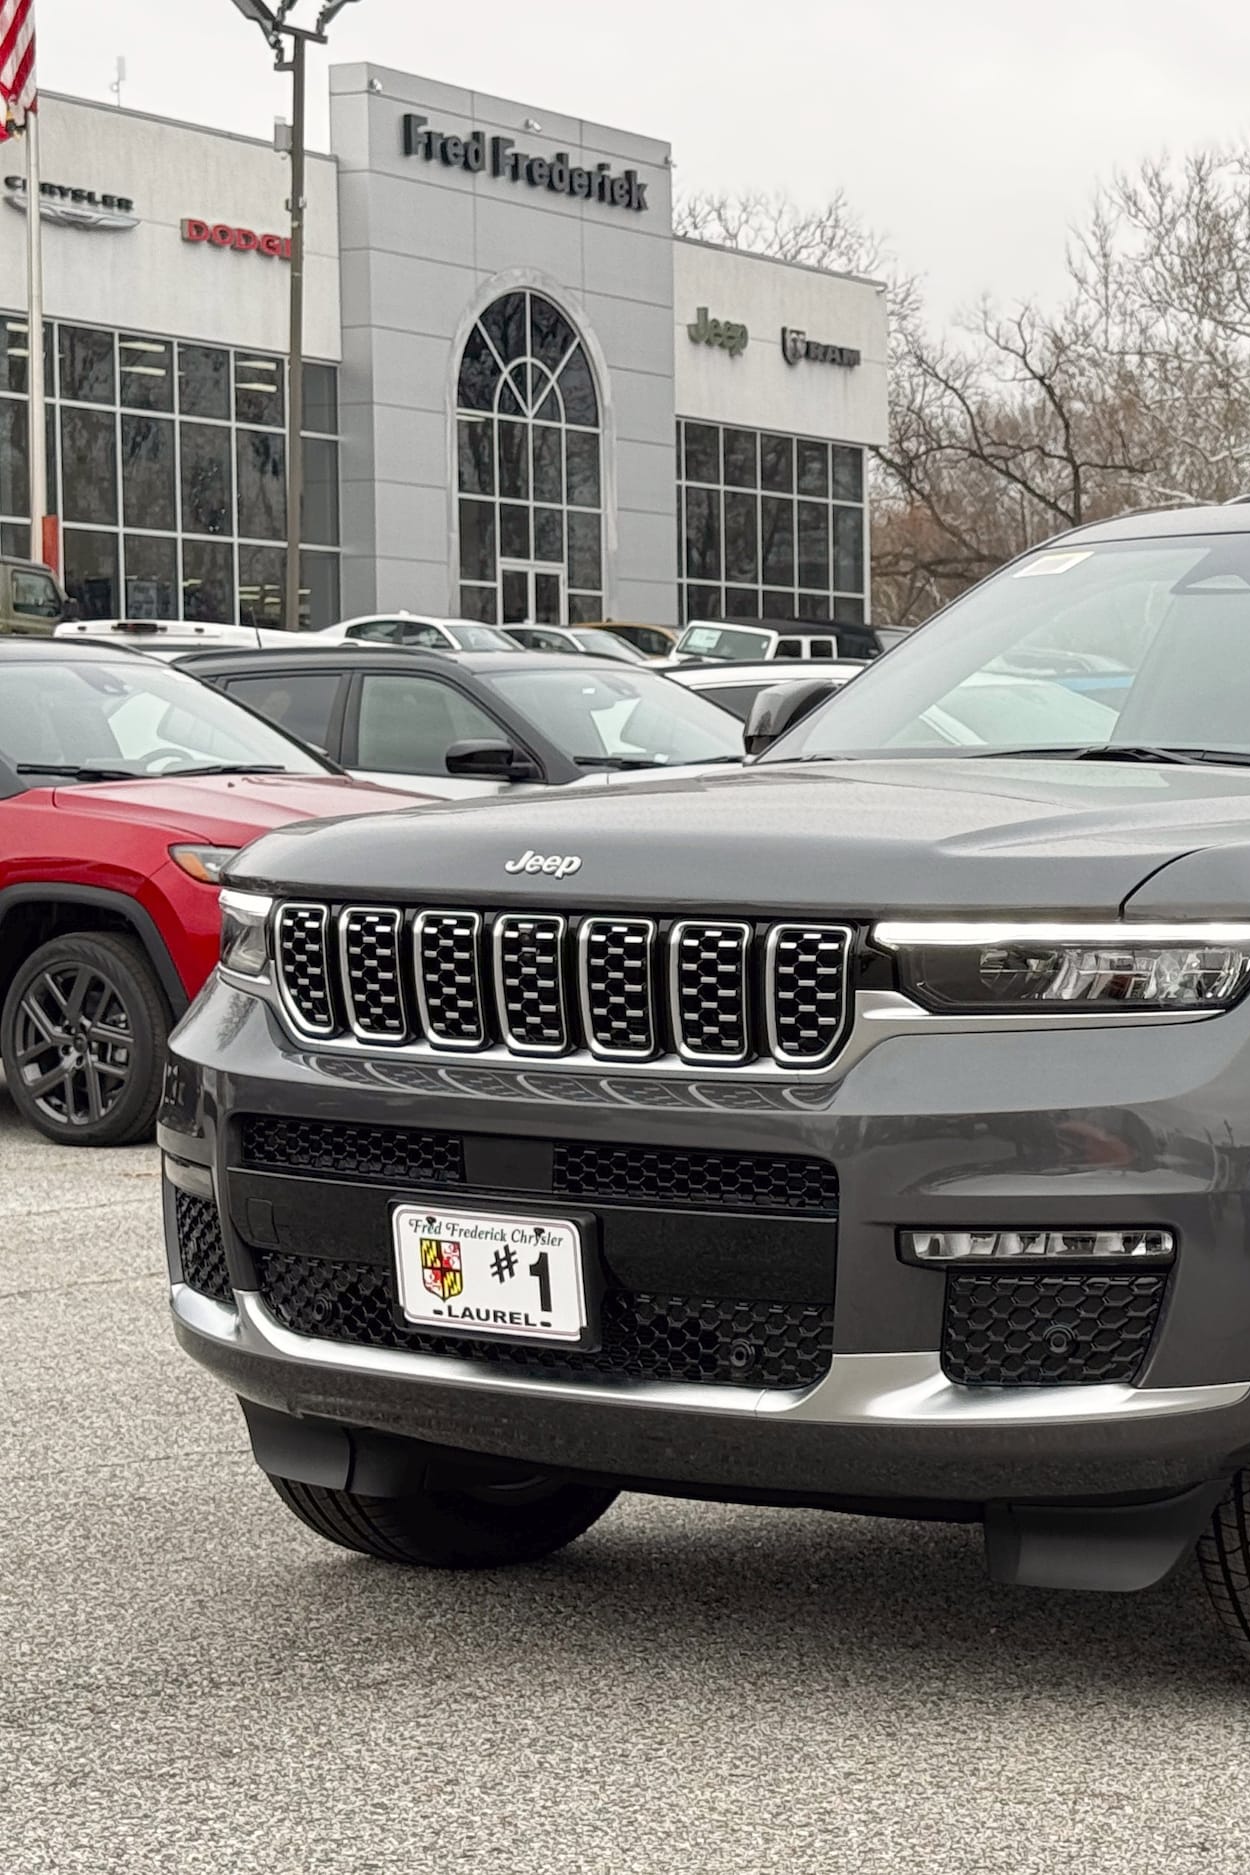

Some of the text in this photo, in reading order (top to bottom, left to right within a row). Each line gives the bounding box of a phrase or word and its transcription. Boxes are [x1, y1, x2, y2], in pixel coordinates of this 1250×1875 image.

[403, 113, 648, 210] Fred Frederick
[687, 307, 748, 357] Jeep
[505, 850, 581, 879] Jeep
[409, 1218, 564, 1247] Fred Frederick Chrysler
